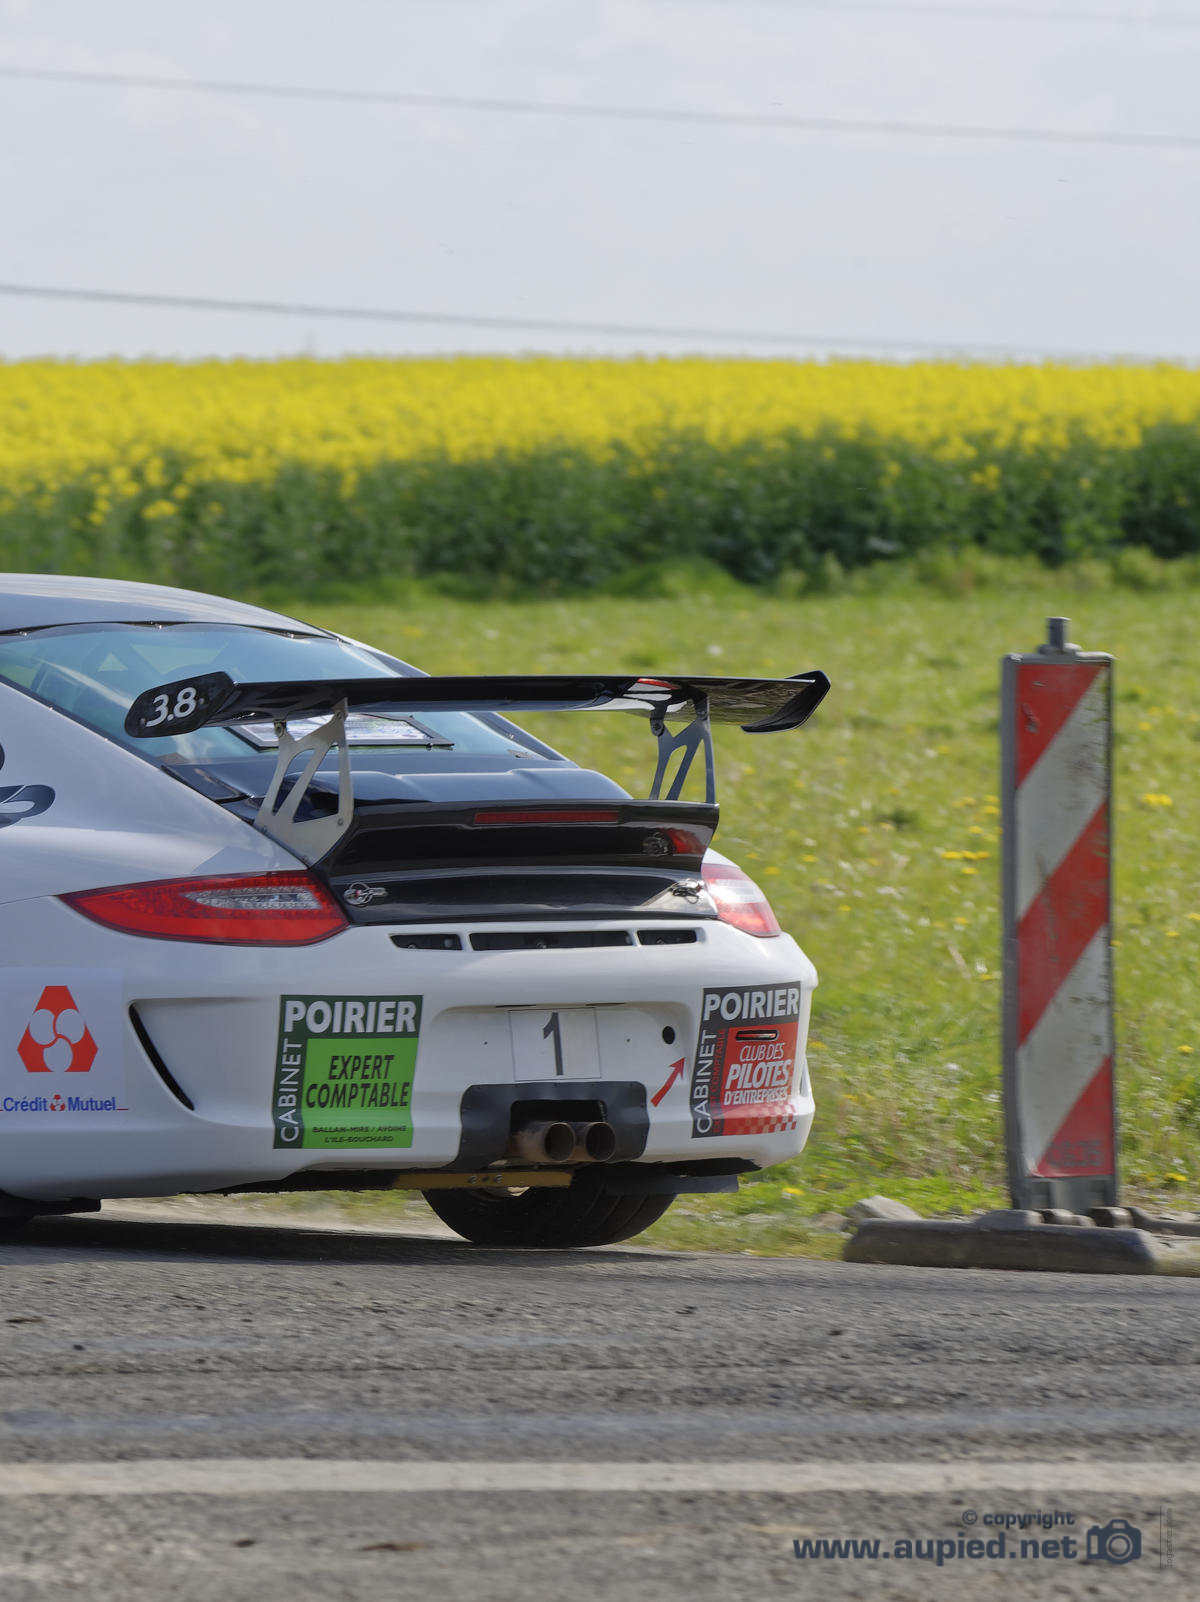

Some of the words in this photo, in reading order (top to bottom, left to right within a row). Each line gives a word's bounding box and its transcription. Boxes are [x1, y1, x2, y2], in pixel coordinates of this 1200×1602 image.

[145, 687, 197, 727] 3.8
[284, 1000, 417, 1033] POIRIER
[702, 988, 800, 1021] POIRIER
[543, 1012, 563, 1075] 1
[740, 1044, 768, 1061] CLUB
[768, 1042, 786, 1060] DES
[328, 1055, 395, 1080] EXPERT
[693, 1030, 718, 1133] CABINET
[725, 1059, 792, 1090] PILOTES
[3, 1096, 48, 1111] Crédit
[68, 1096, 116, 1111] Mutuel
[278, 1038, 303, 1142] CABINET
[306, 1082, 410, 1108] COMPTABLE
